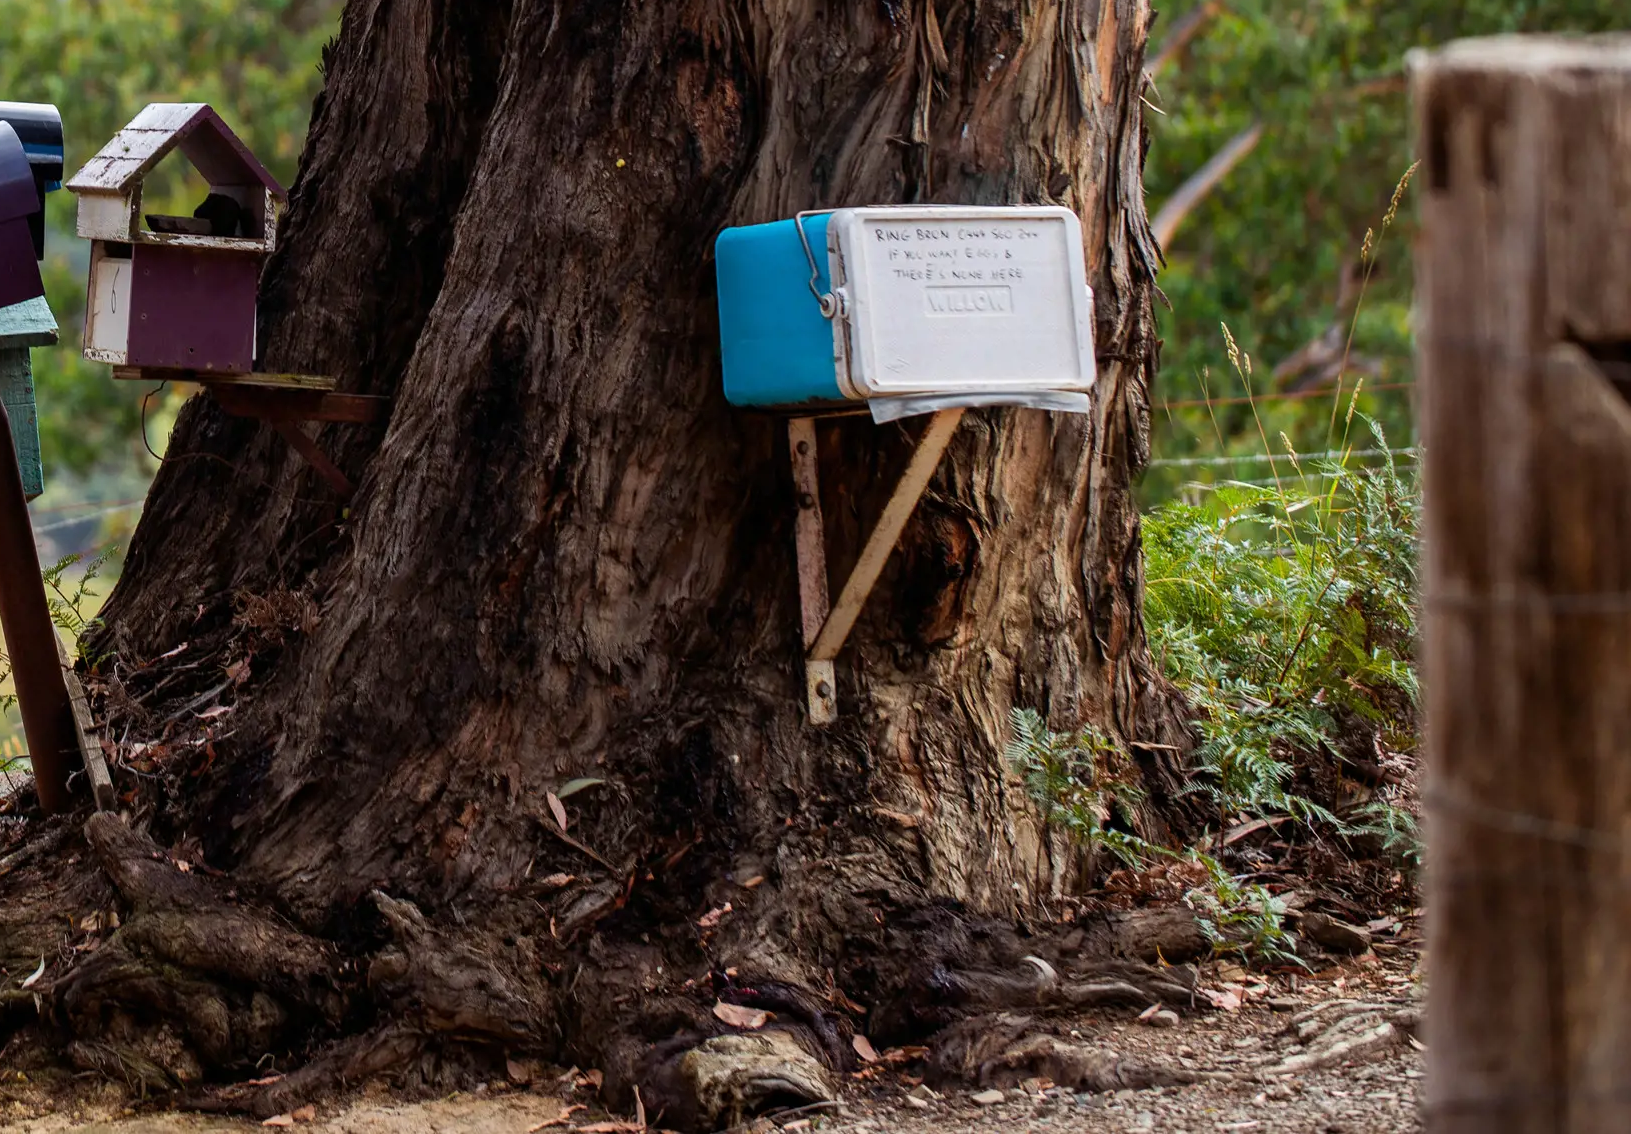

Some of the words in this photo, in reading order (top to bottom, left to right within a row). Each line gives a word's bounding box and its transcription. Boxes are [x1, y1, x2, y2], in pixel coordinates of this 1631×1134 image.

[874, 227, 910, 242] RING
[990, 267, 1025, 280] HERE
[926, 289, 1009, 313] WILLOW
